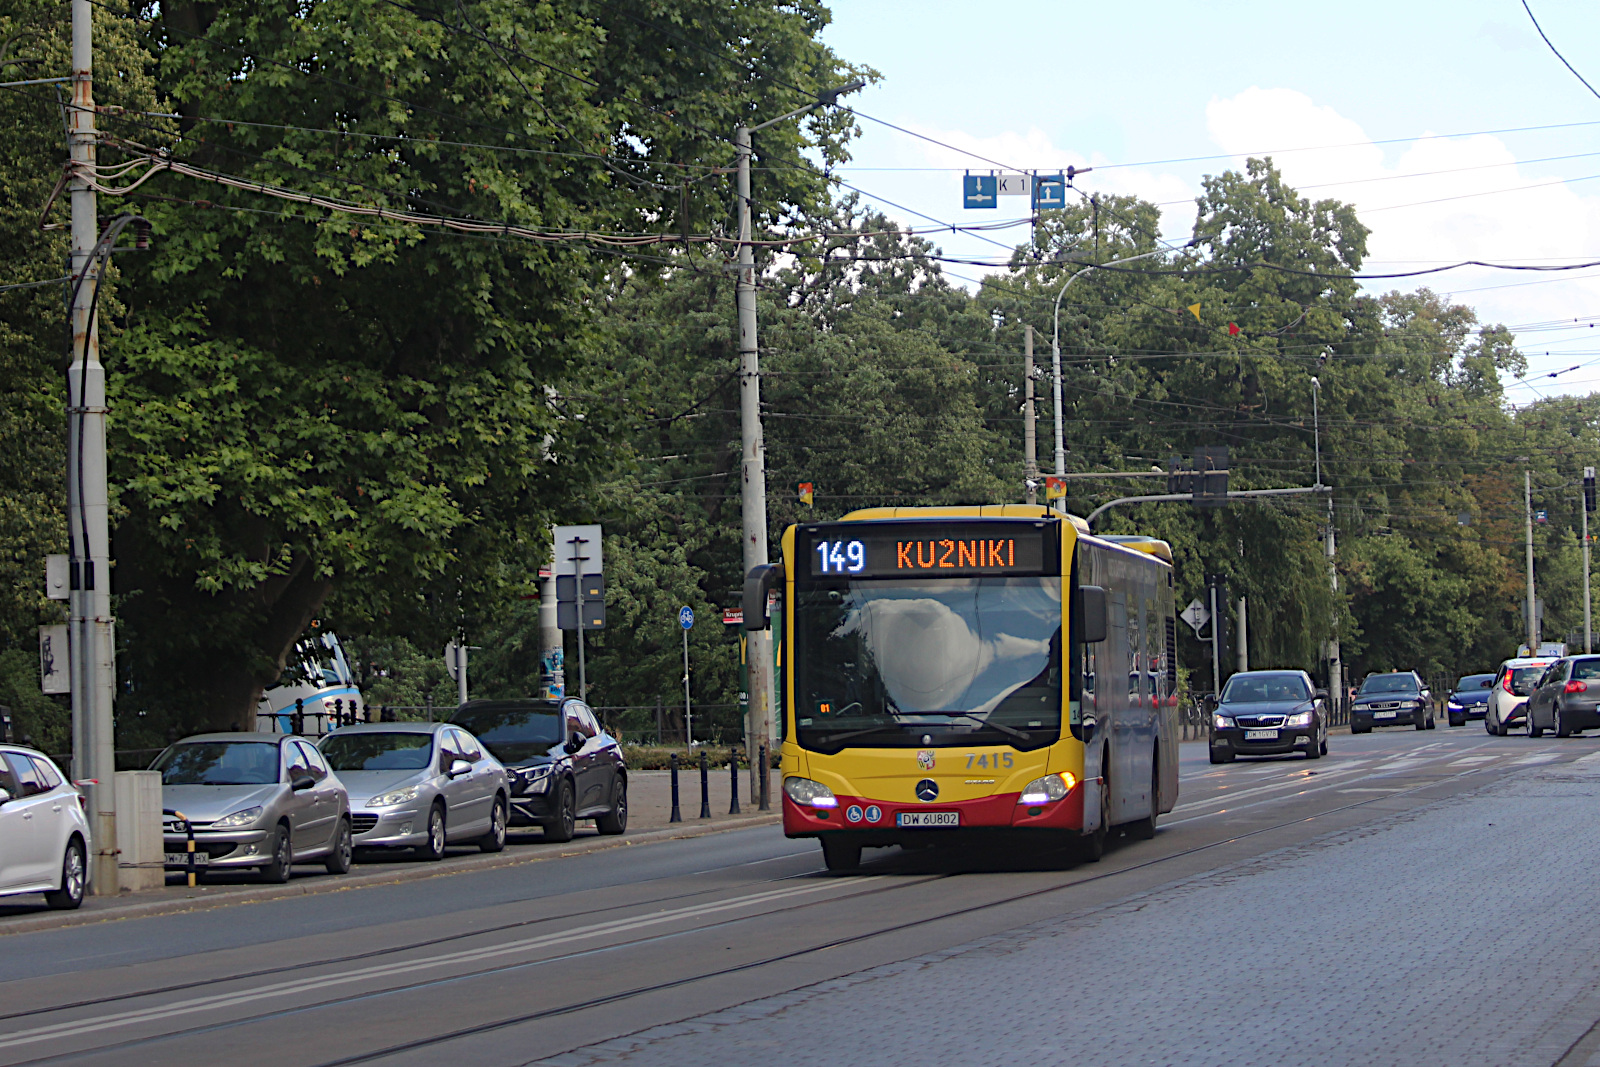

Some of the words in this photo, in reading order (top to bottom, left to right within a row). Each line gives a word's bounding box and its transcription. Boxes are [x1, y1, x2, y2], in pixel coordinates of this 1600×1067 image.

[999, 179, 1008, 191] K
[1020, 179, 1026, 191] 1
[817, 541, 864, 572] 149
[965, 752, 1014, 769] 7415
[903, 814, 920, 825] DW
[923, 814, 957, 825] 6U802
[179, 853, 207, 864] 72HX
